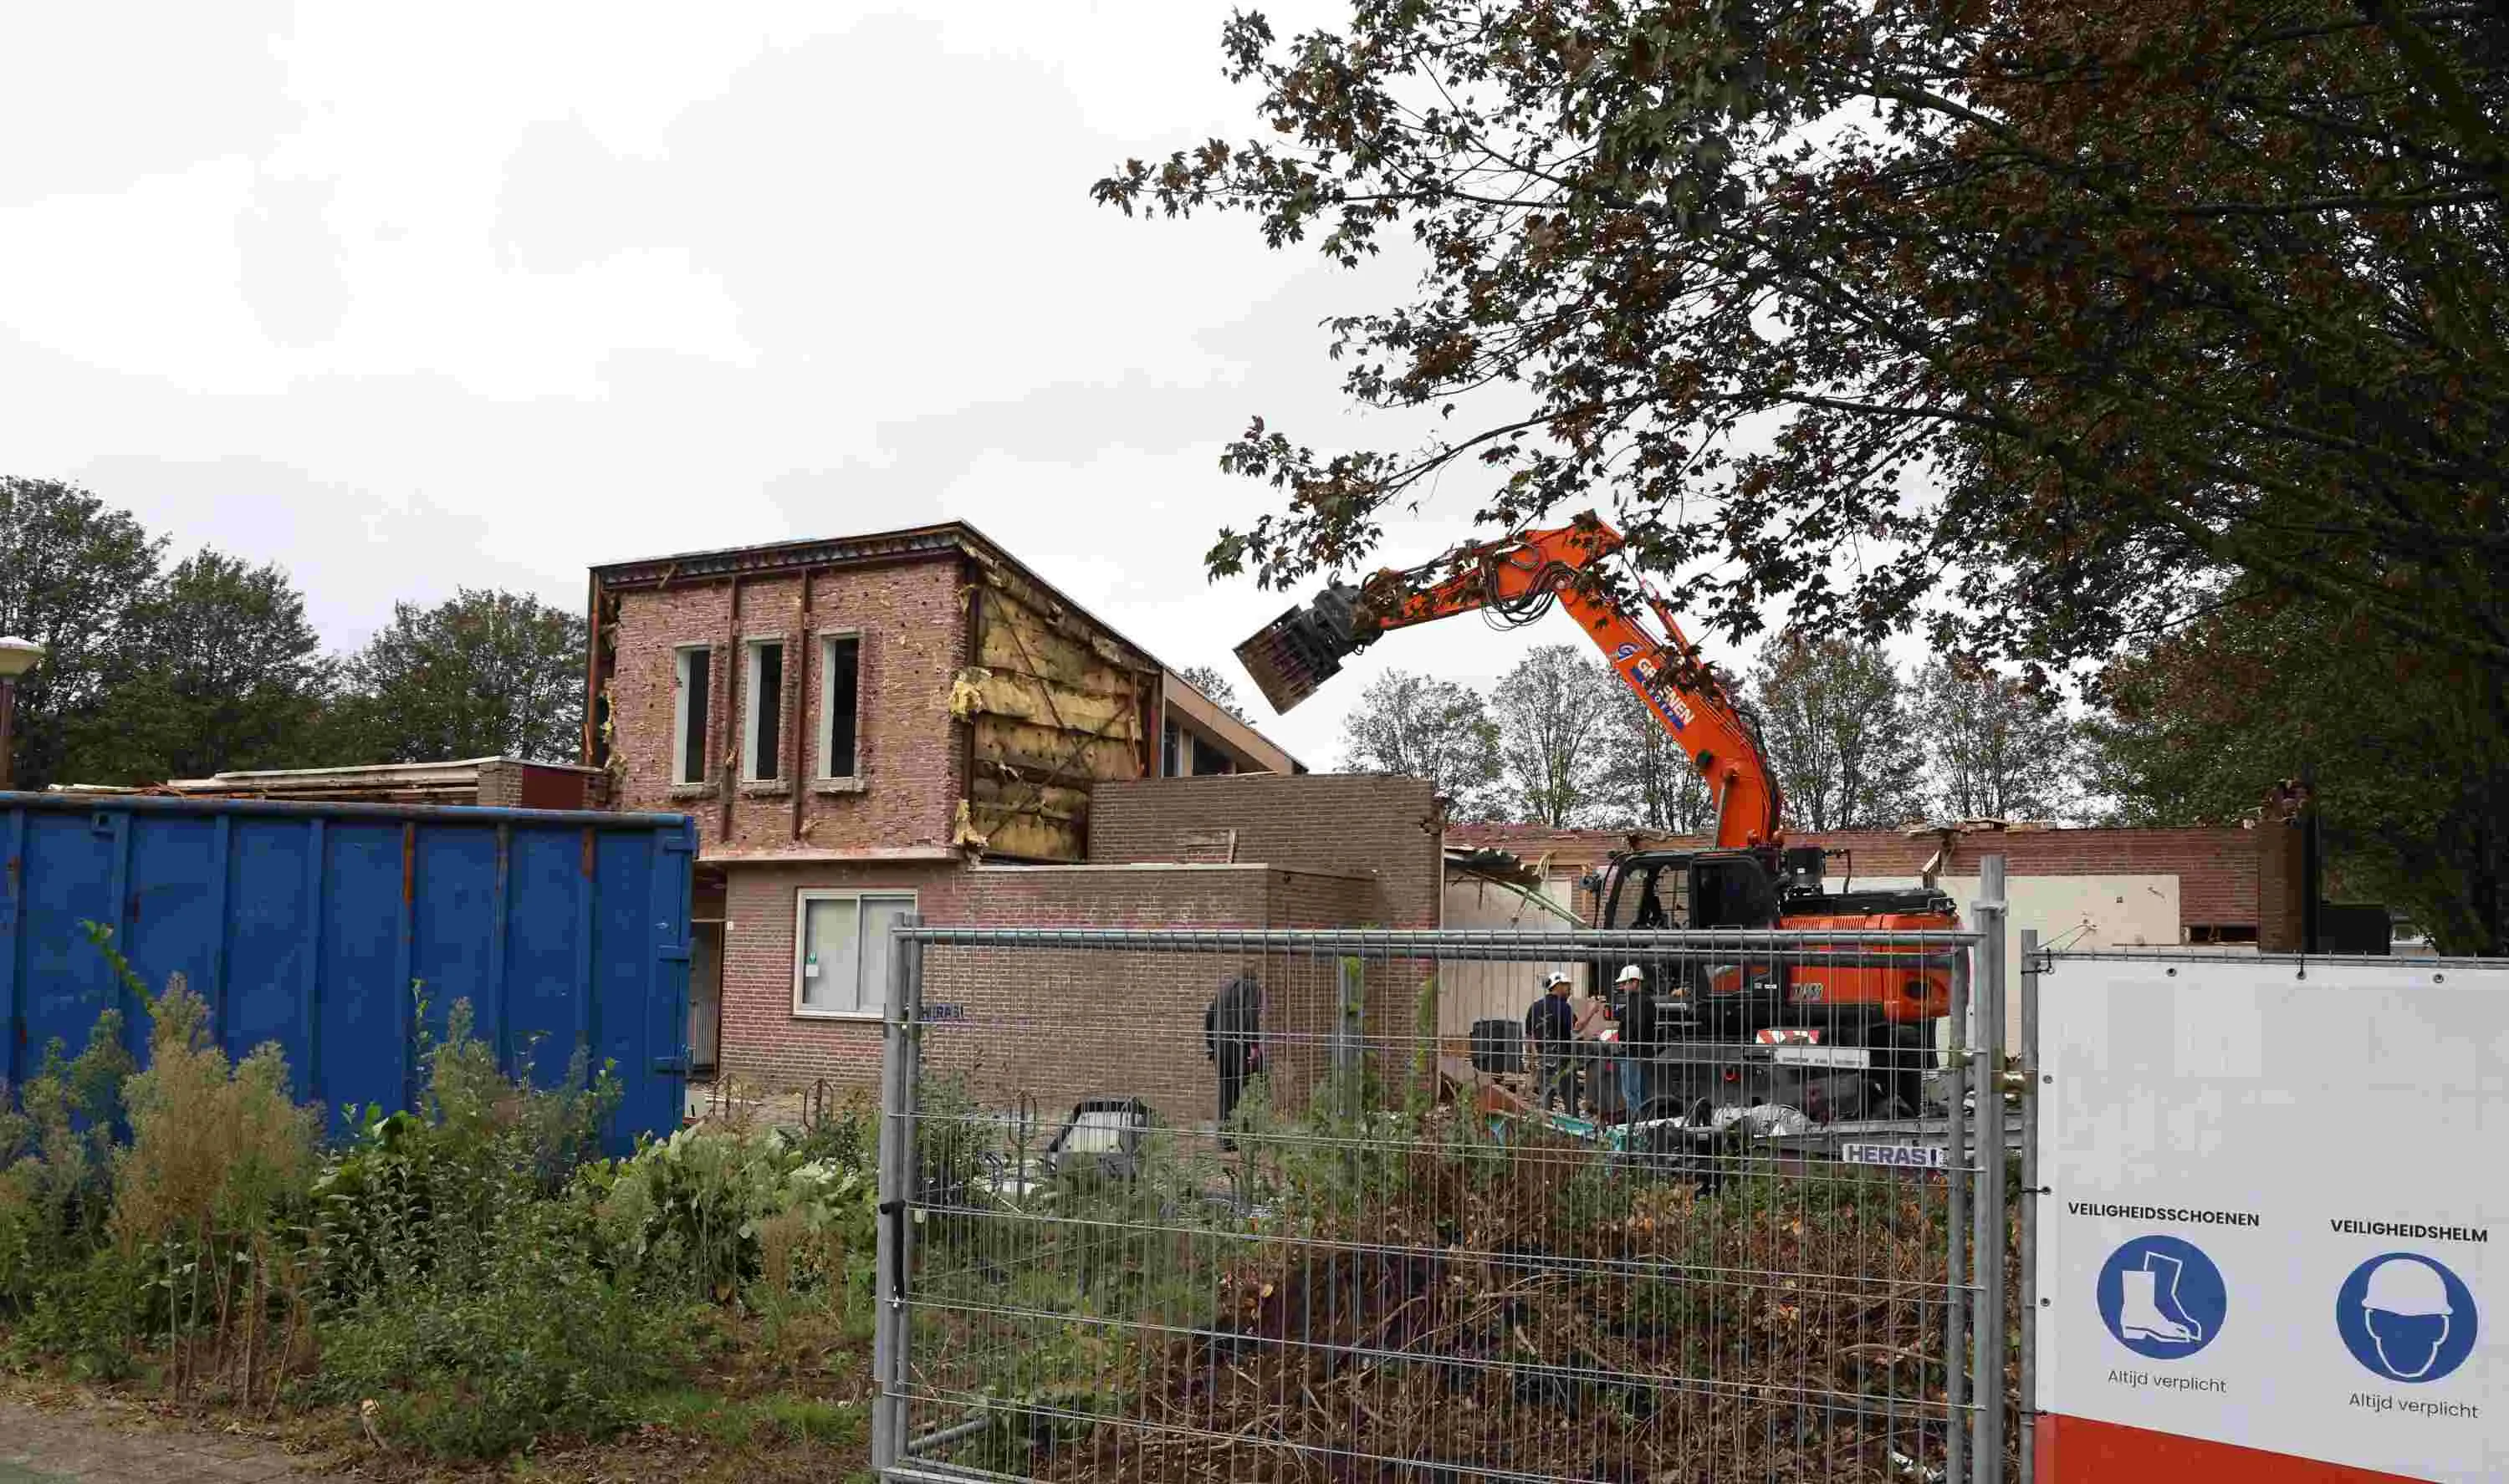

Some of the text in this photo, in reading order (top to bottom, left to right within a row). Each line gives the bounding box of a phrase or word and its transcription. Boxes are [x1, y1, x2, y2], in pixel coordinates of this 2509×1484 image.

[1638, 657, 1695, 724] GRENEN
[2067, 1201, 2260, 1226] VEILIGHEIDSSCHOENEN
[2330, 1219, 2488, 1242] VEILIGHEIDSHELM
[2108, 1369, 2227, 1393] Altijd verplicht
[2348, 1392, 2479, 1419] Altijd verplicht
